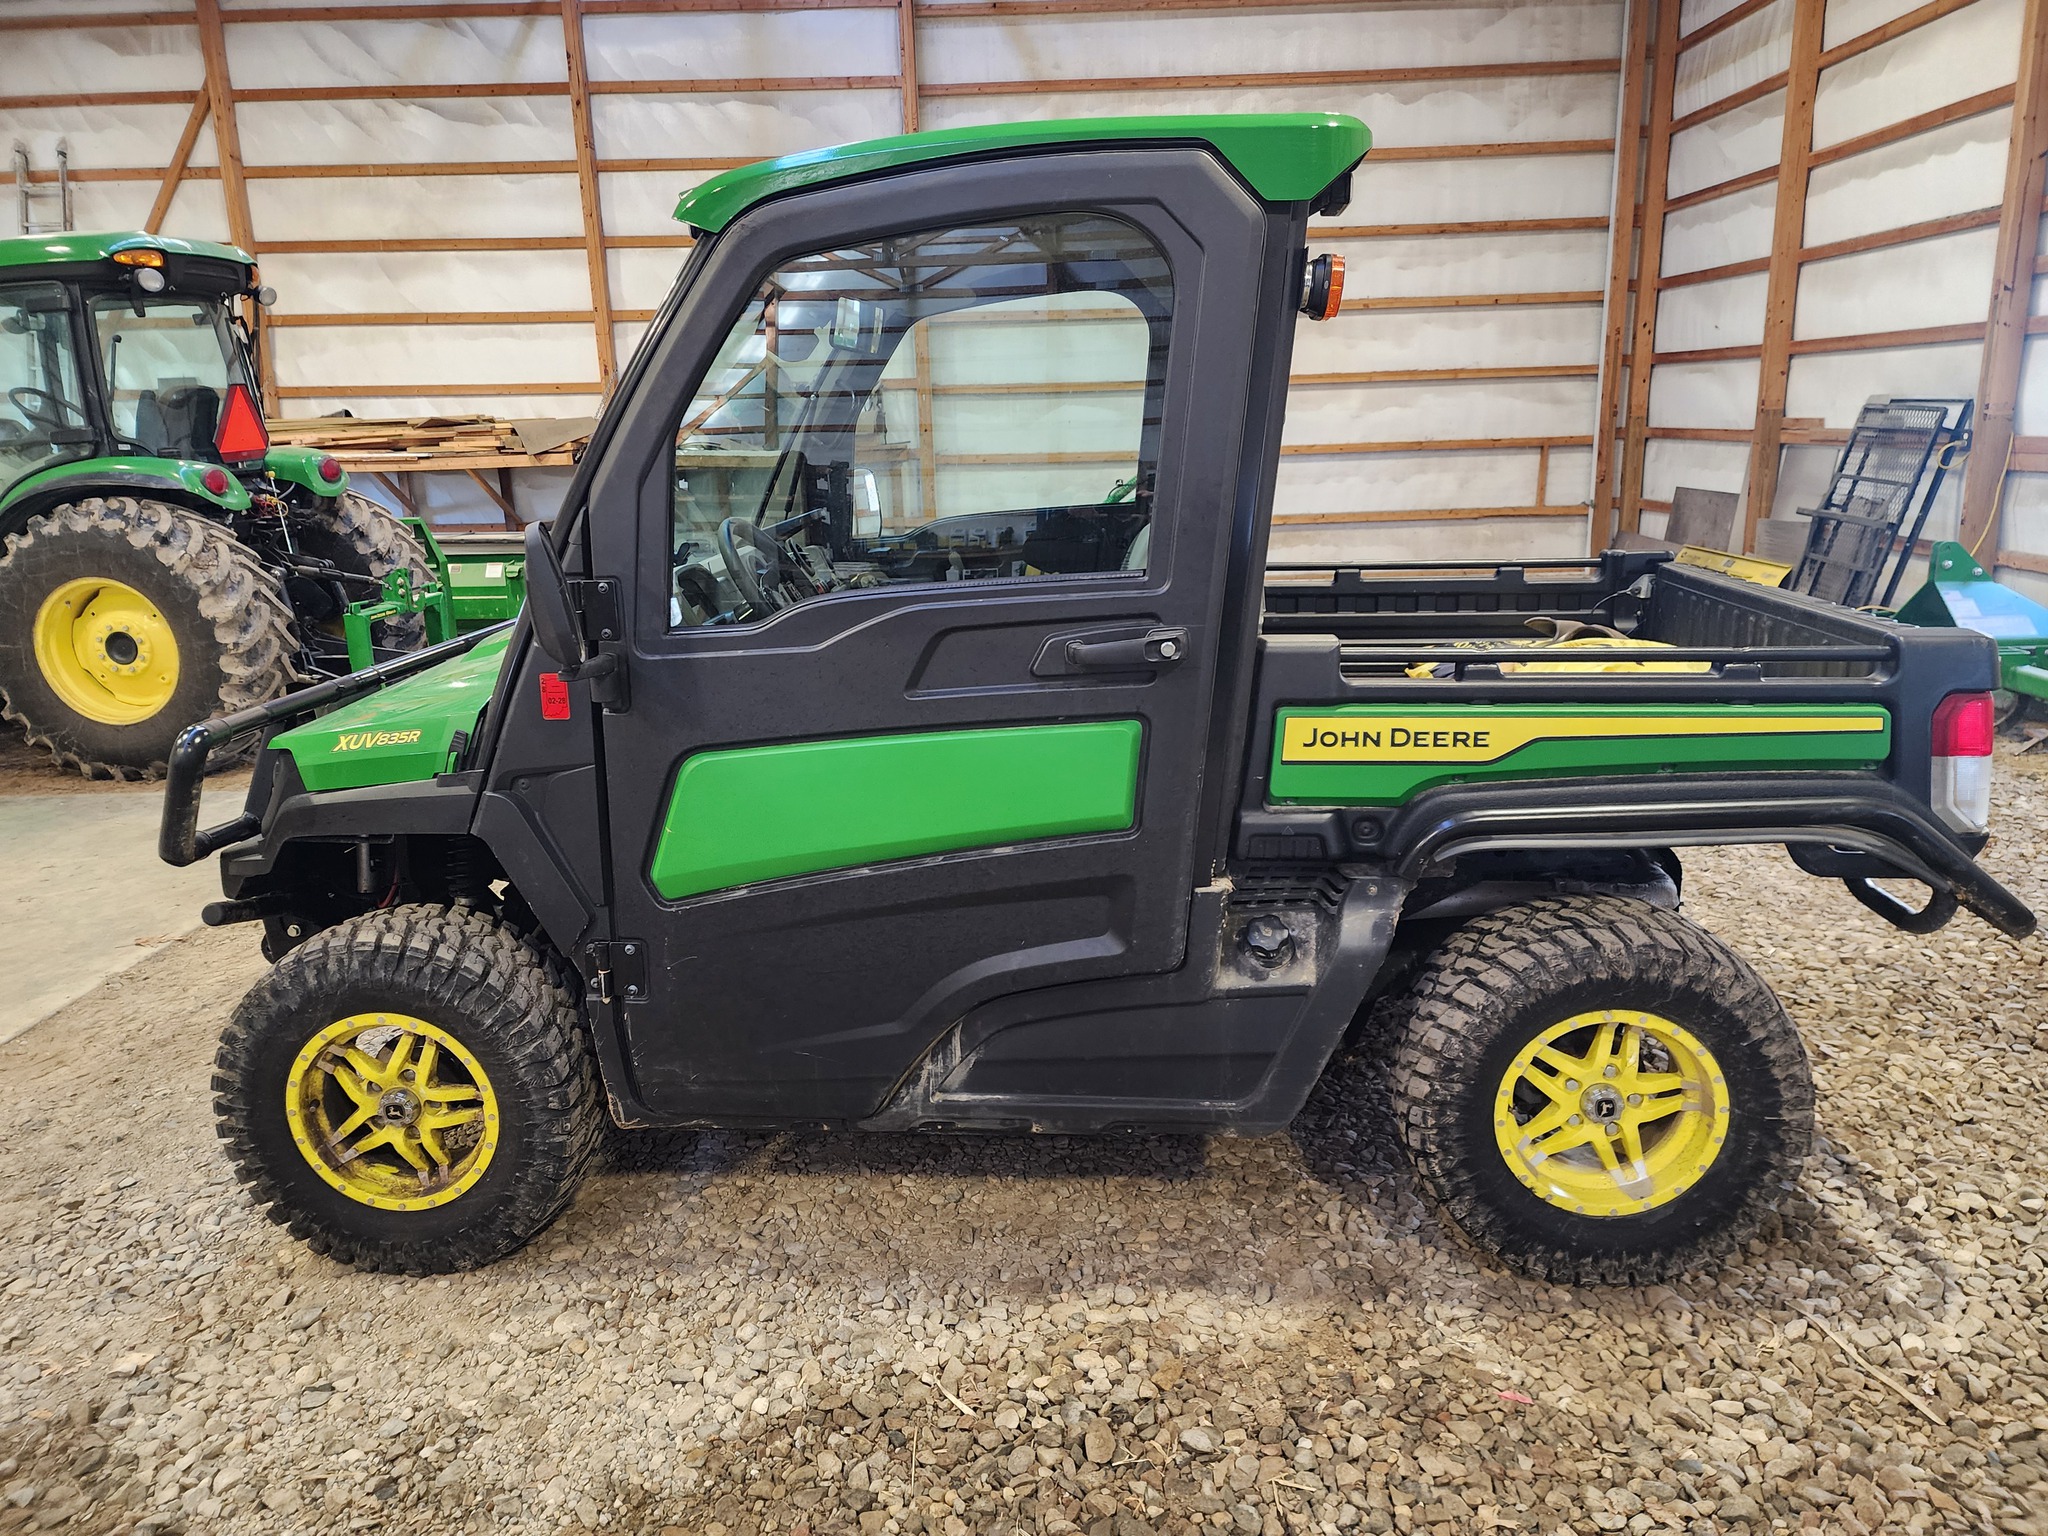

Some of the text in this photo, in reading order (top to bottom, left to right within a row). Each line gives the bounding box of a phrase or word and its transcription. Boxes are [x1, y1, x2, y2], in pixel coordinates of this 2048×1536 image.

[331, 730, 421, 752] XUV835R
[1303, 728, 1490, 748] JOHN DEERE
